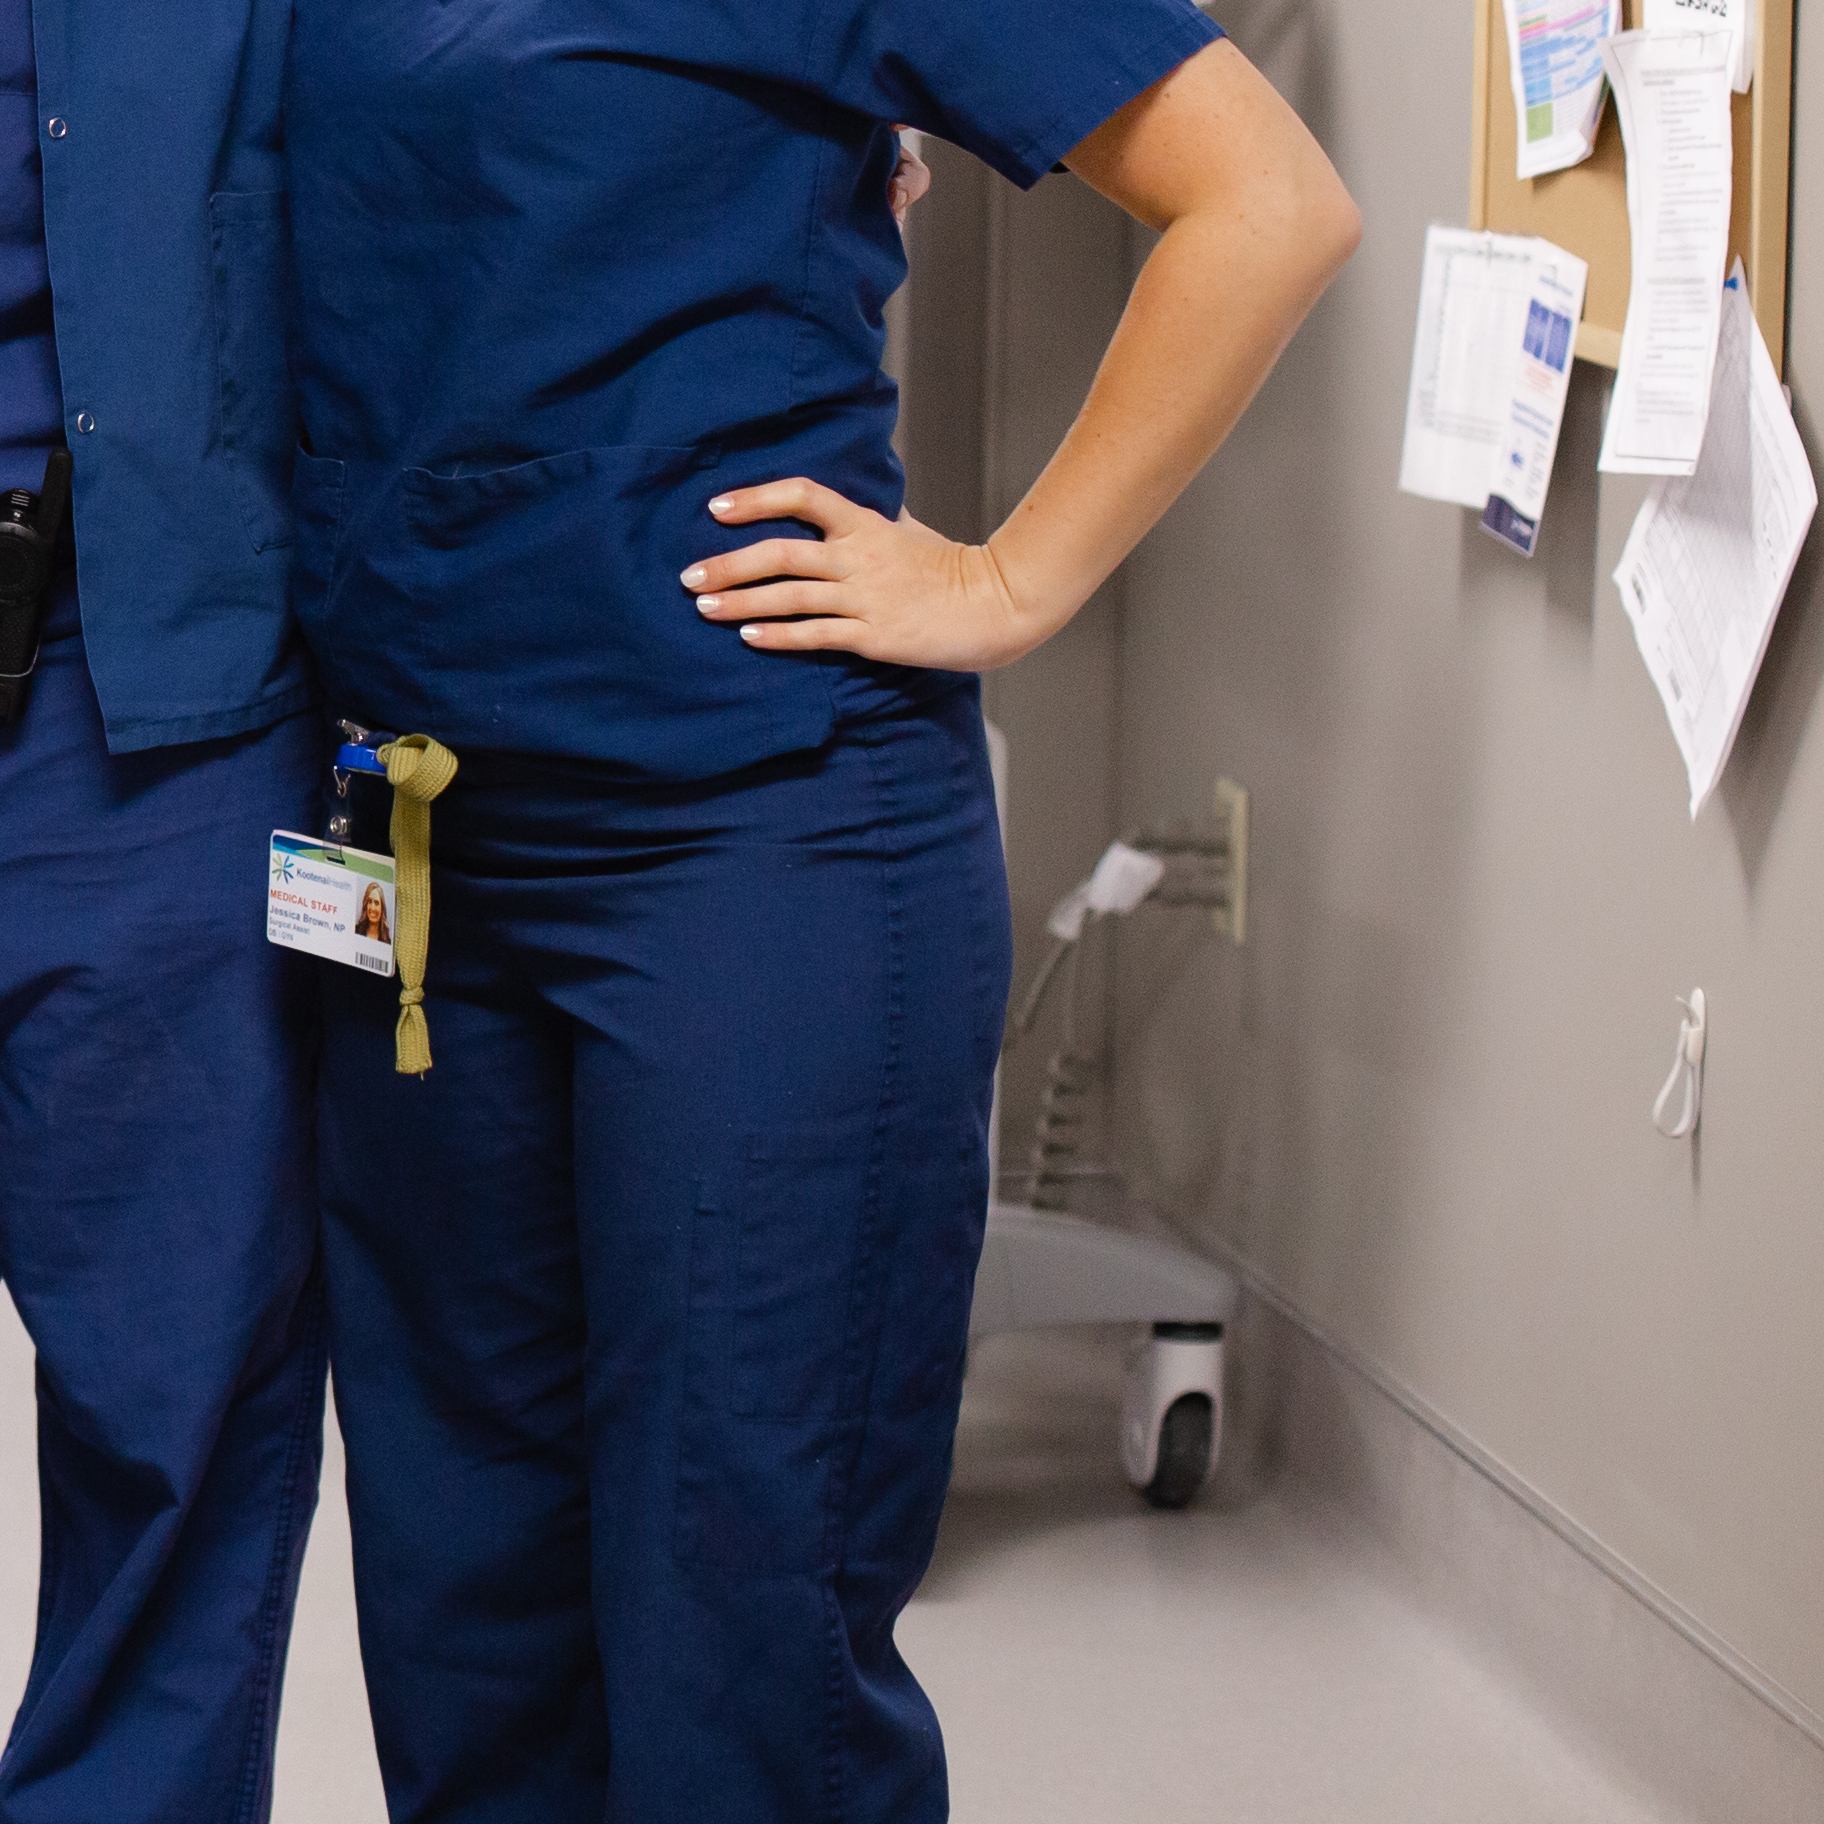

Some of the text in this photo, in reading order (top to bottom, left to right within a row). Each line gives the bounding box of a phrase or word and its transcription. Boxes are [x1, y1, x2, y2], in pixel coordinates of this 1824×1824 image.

[269, 888, 338, 915] MEDICAL STAFF
[269, 905, 346, 933] Jessica Brown, NP
